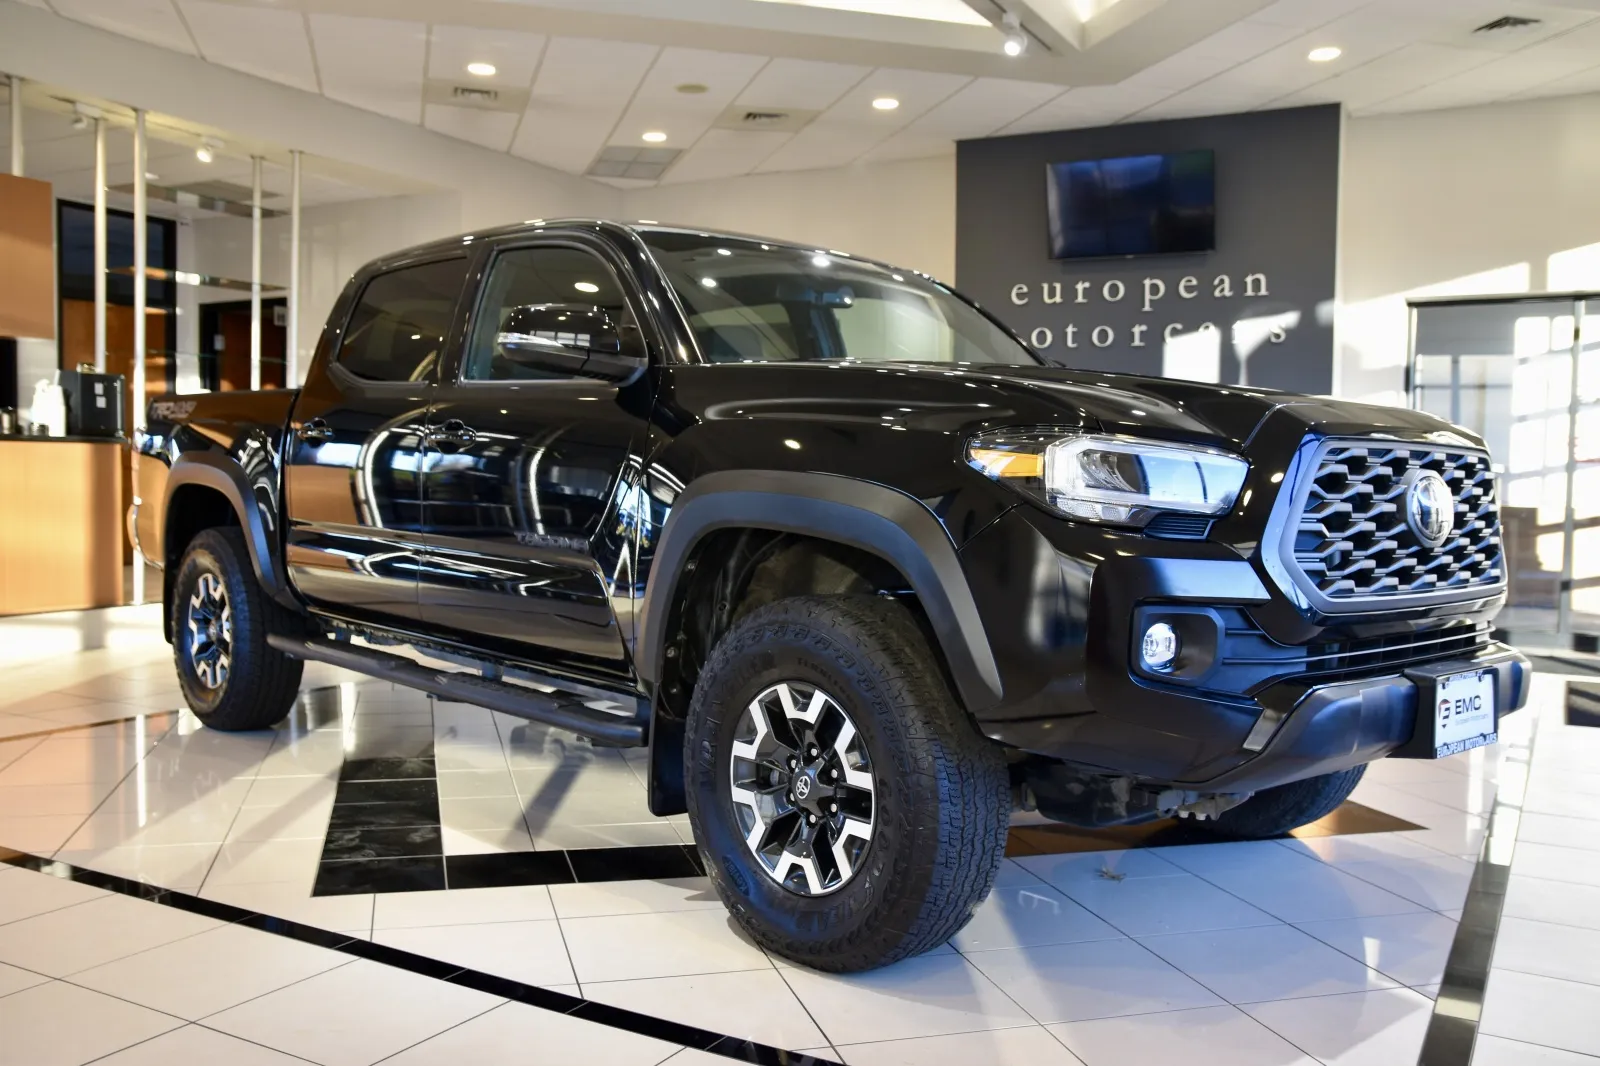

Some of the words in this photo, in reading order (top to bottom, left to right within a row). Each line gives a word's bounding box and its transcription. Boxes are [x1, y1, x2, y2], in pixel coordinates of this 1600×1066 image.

[1010, 271, 1270, 312] european
[1020, 321, 1287, 349] otorcs
[1455, 694, 1482, 716] EMC
